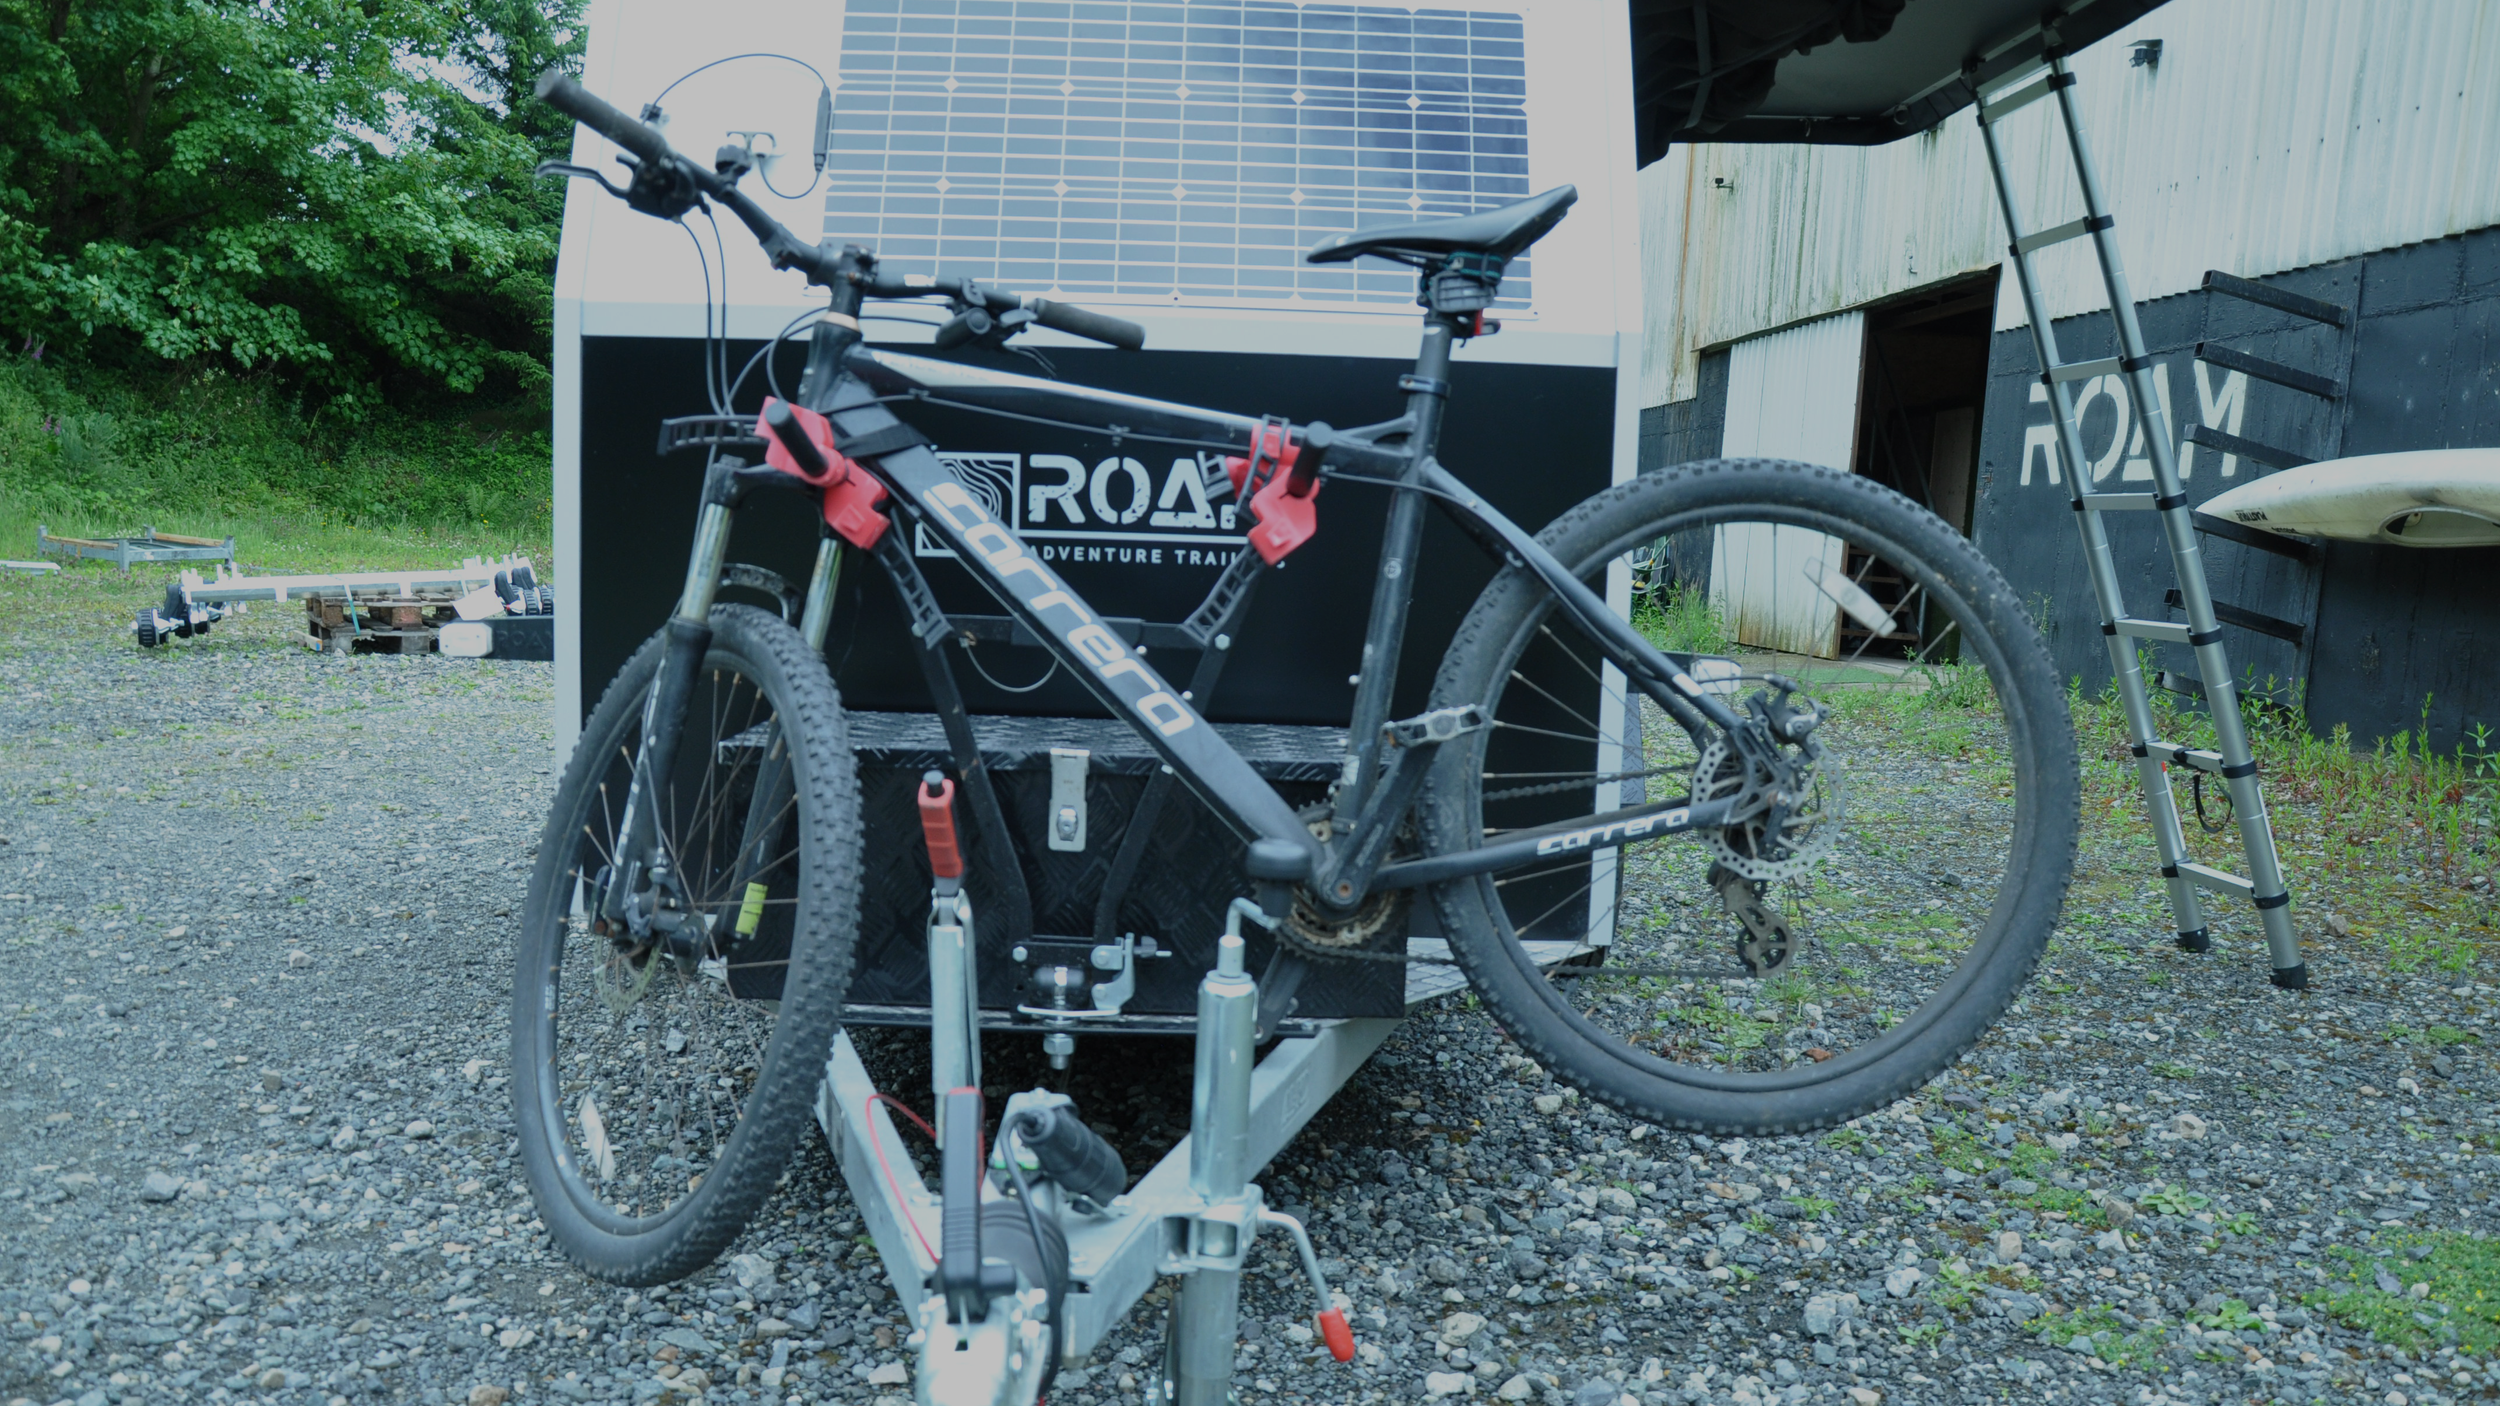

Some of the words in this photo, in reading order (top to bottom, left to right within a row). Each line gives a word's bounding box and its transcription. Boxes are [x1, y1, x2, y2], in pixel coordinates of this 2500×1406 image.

[1028, 454, 1238, 531] ROA
[495, 630, 552, 650] ROA
[923, 482, 1195, 737] carrera
[1536, 808, 1690, 856] carrera
